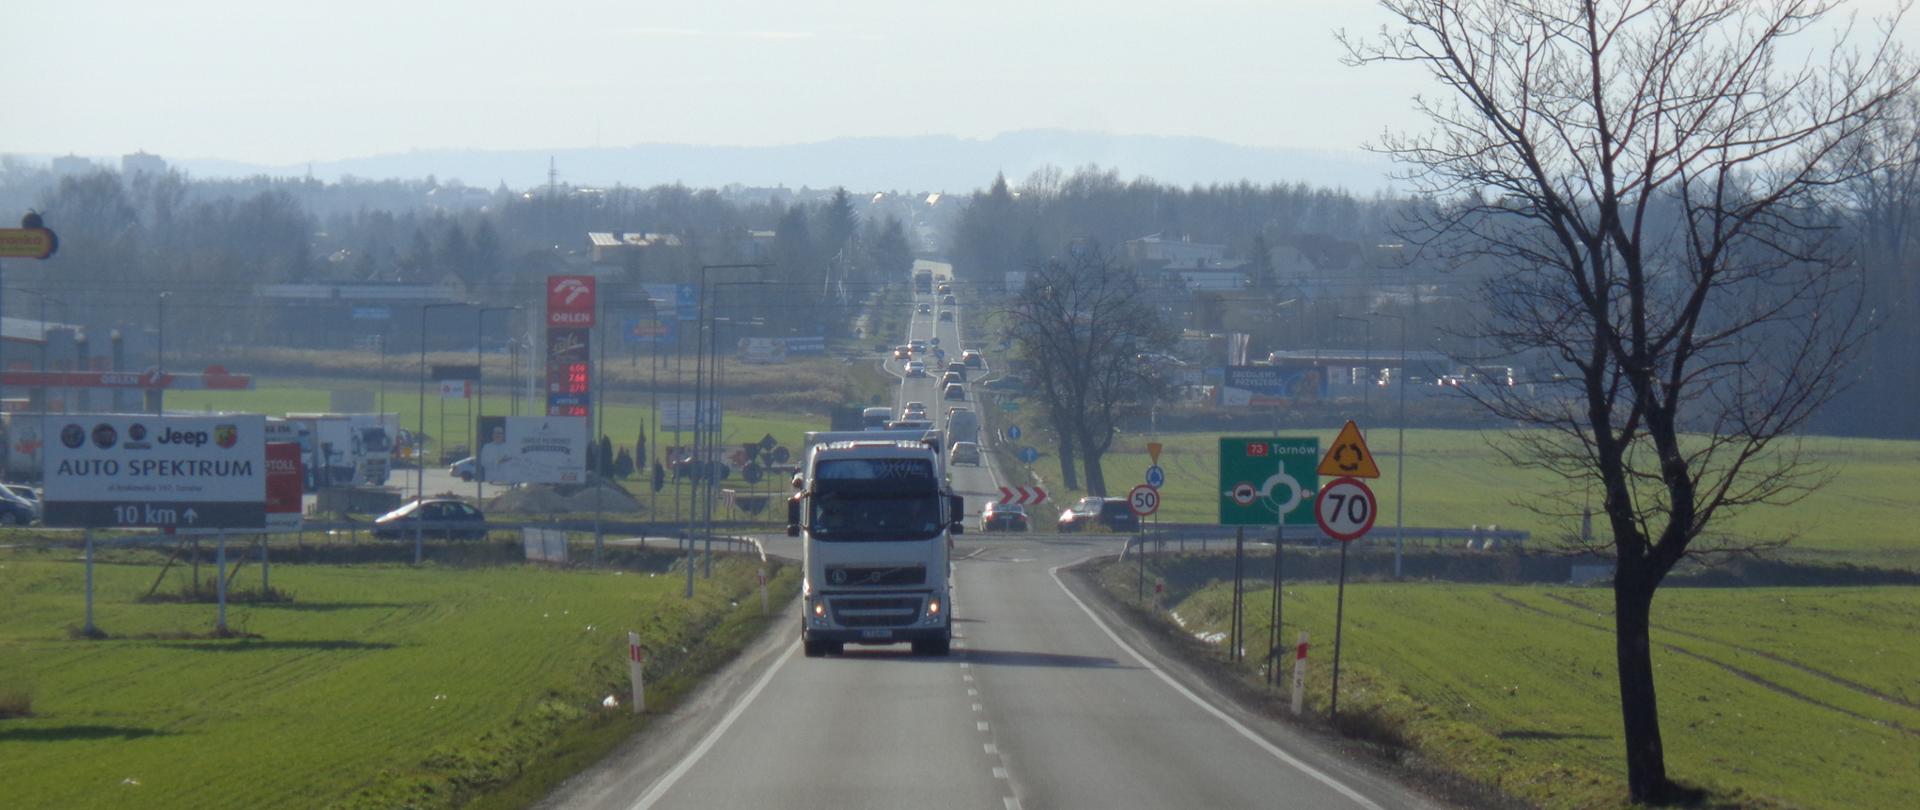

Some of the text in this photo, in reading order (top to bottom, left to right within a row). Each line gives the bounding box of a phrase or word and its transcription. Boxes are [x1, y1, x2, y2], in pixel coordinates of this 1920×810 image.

[552, 313, 590, 322] ORLEN
[101, 375, 138, 384] ORLEN
[158, 427, 208, 447] Jeep
[1251, 443, 1316, 455] 73 Tarnów
[58, 459, 252, 476] AUTO SPEKTRUM
[1135, 493, 1155, 508] 50
[1328, 493, 1368, 524] 70
[113, 503, 177, 523] 10 km
